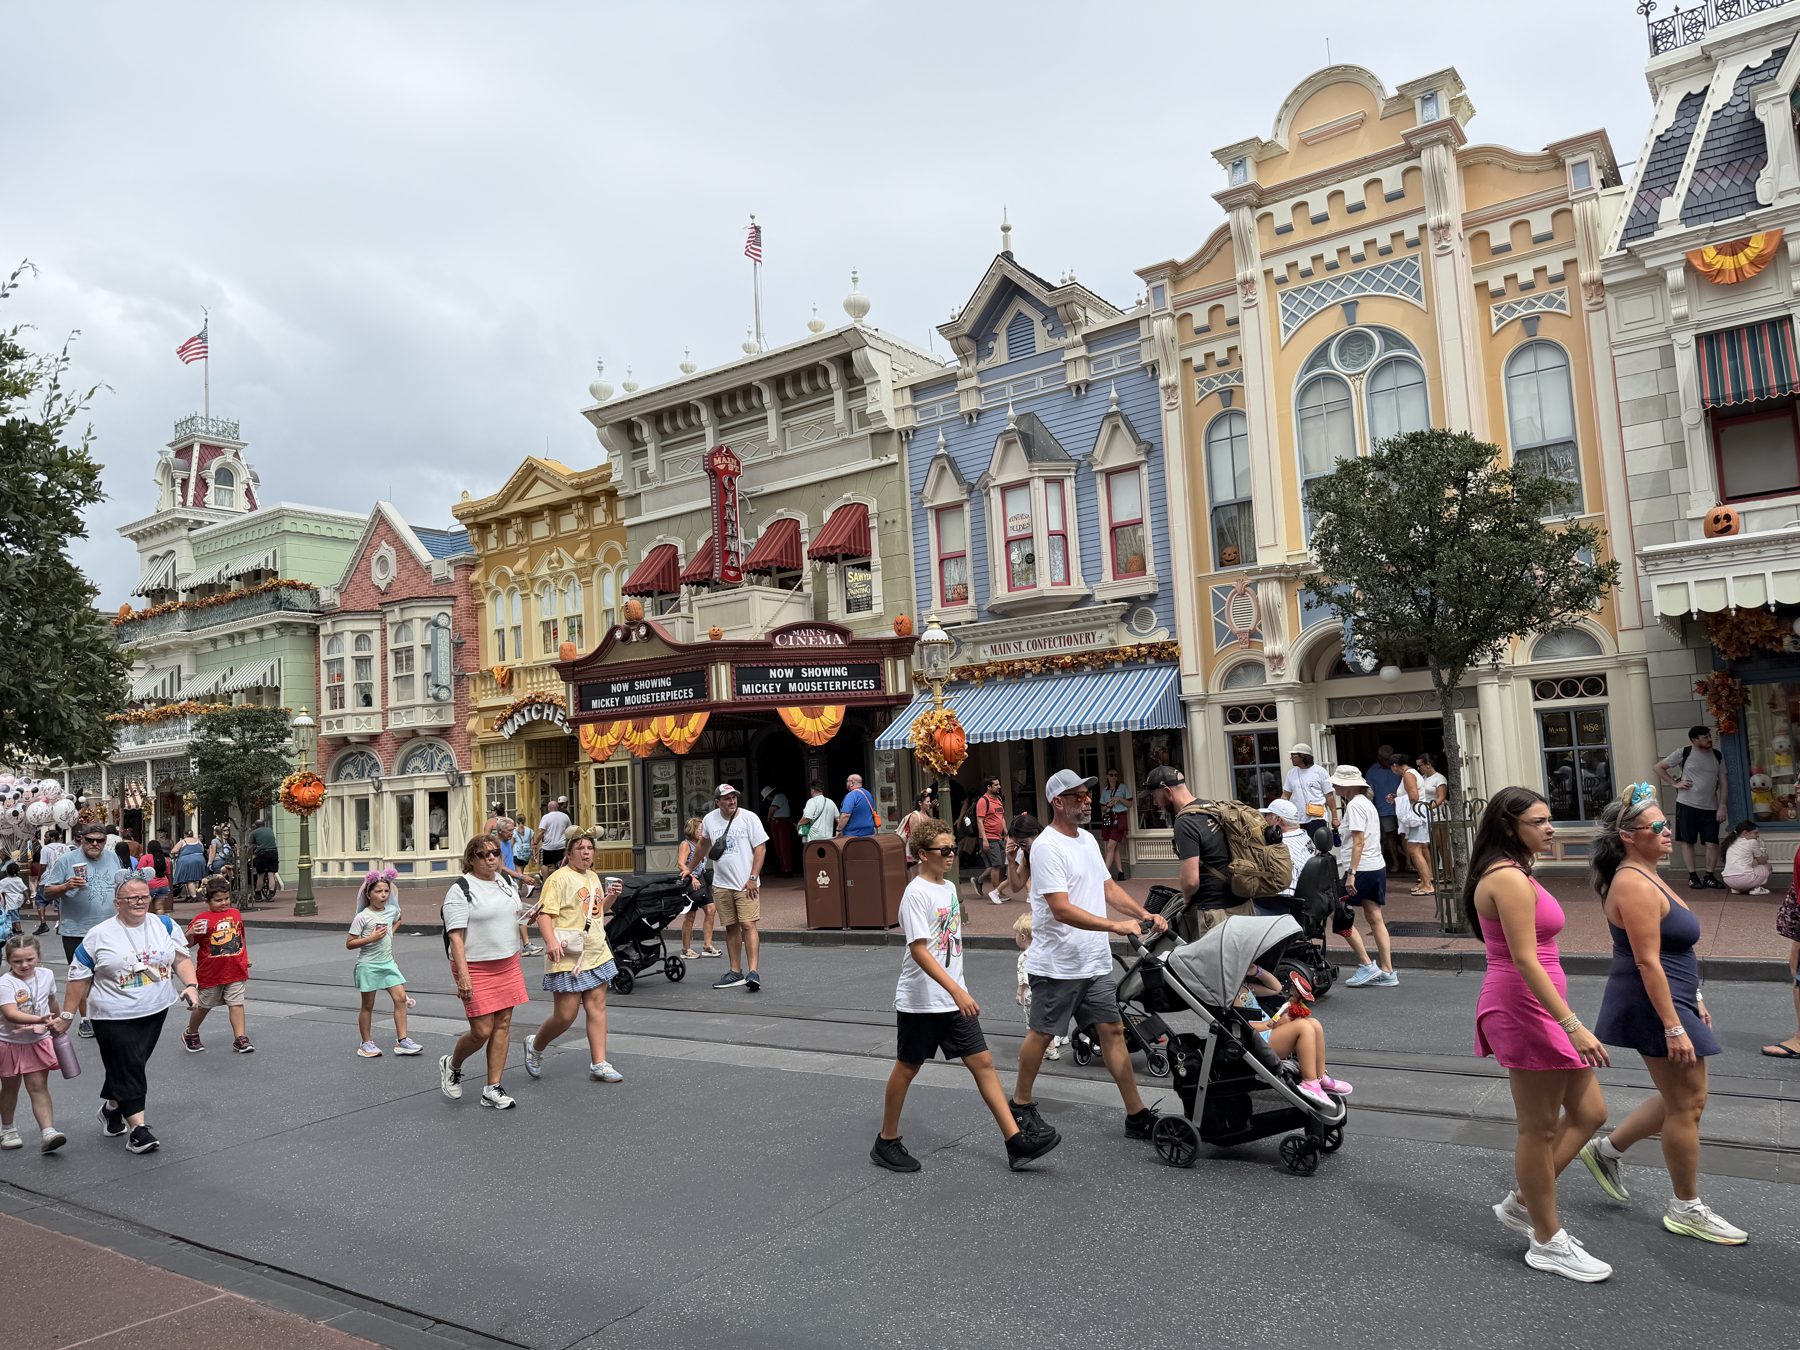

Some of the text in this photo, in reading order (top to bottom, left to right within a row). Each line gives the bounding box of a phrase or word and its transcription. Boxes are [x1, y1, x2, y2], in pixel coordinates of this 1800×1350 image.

[722, 475, 739, 568] CINEMA
[775, 633, 844, 646] CINEMA
[792, 628, 815, 637] MAIN
[990, 631, 1097, 656] MAIN ST. CONFECTIONERY
[769, 667, 848, 678] NOW SHOWING
[611, 676, 672, 693] NOW SHOWING
[742, 680, 875, 694] MICKEY MOUSETERPIECES
[591, 688, 694, 709] MICKEY MOUSETERPIECES
